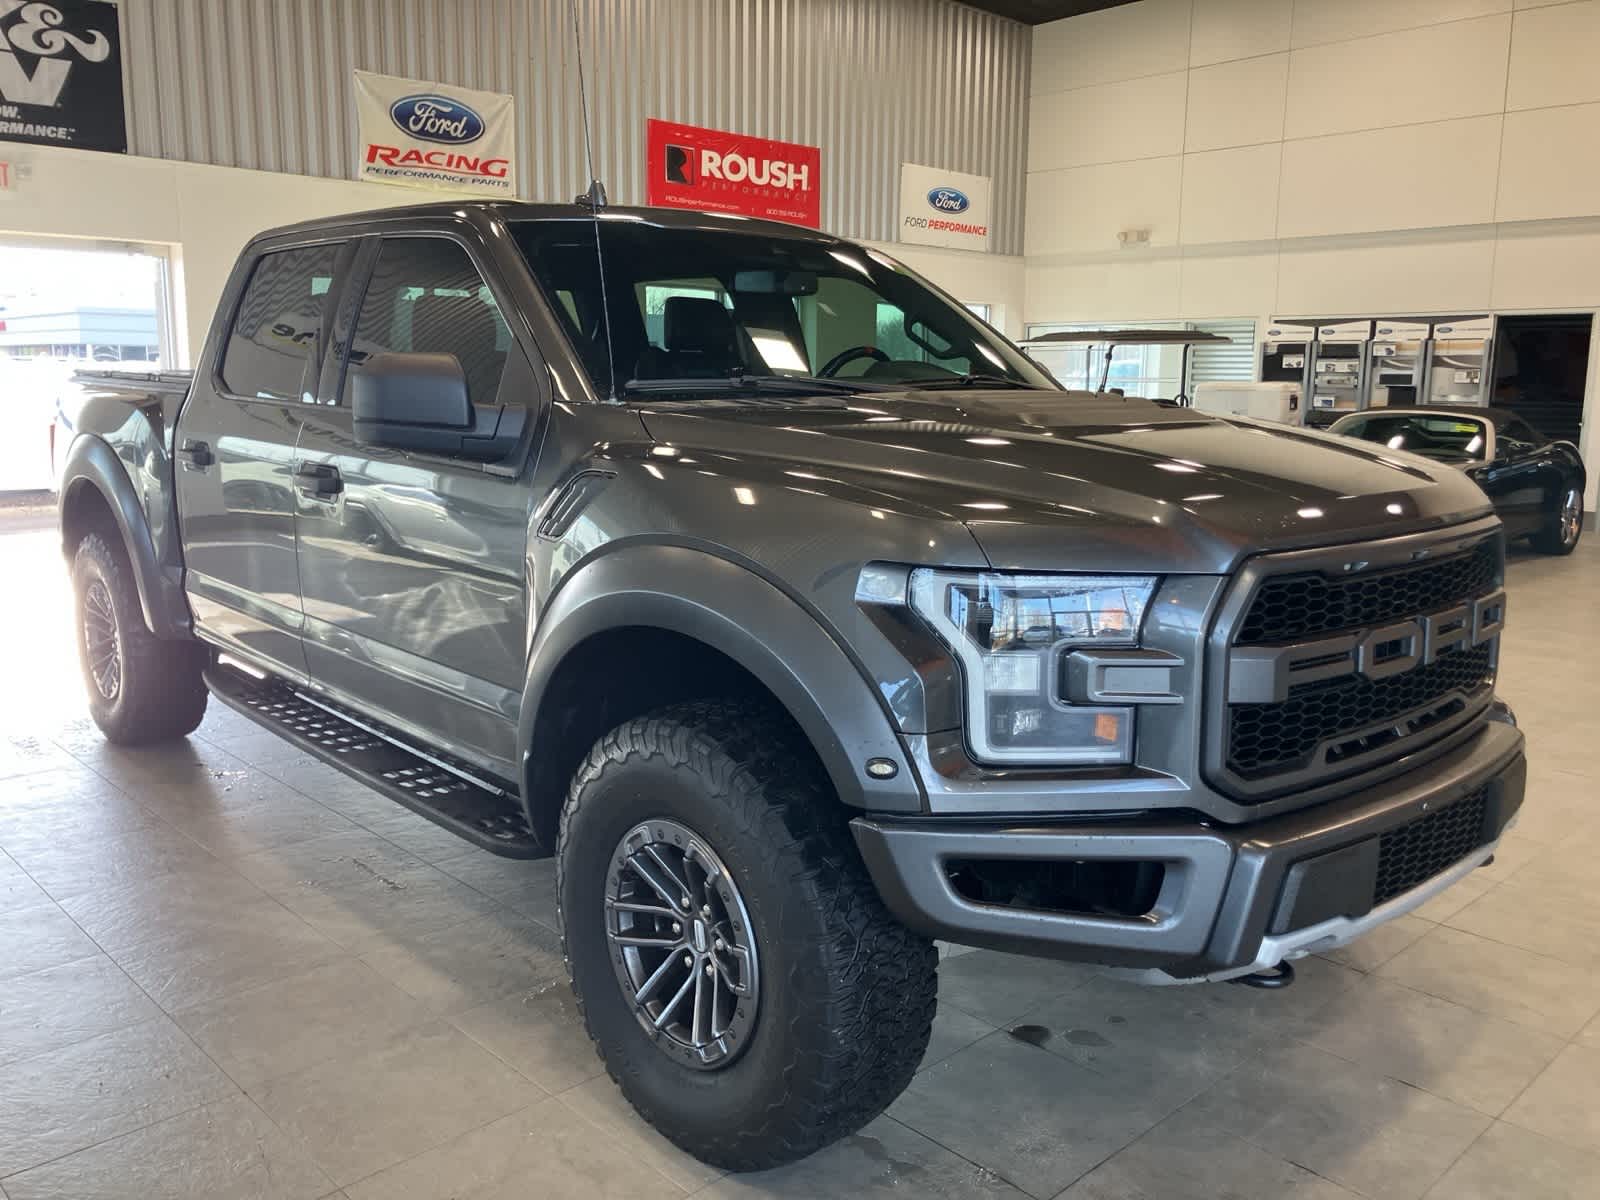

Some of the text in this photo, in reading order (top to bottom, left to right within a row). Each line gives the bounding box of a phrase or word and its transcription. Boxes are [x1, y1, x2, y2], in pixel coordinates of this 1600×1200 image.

[409, 101, 468, 138] Ford
[366, 144, 509, 178] RACING
[366, 166, 510, 188] PERFORMANCE PARTS
[701, 149, 809, 192] ROUSH
[935, 190, 962, 210] Ford
[904, 216, 988, 237] FORD PERFORMANCE
[1272, 588, 1507, 696] FORD
